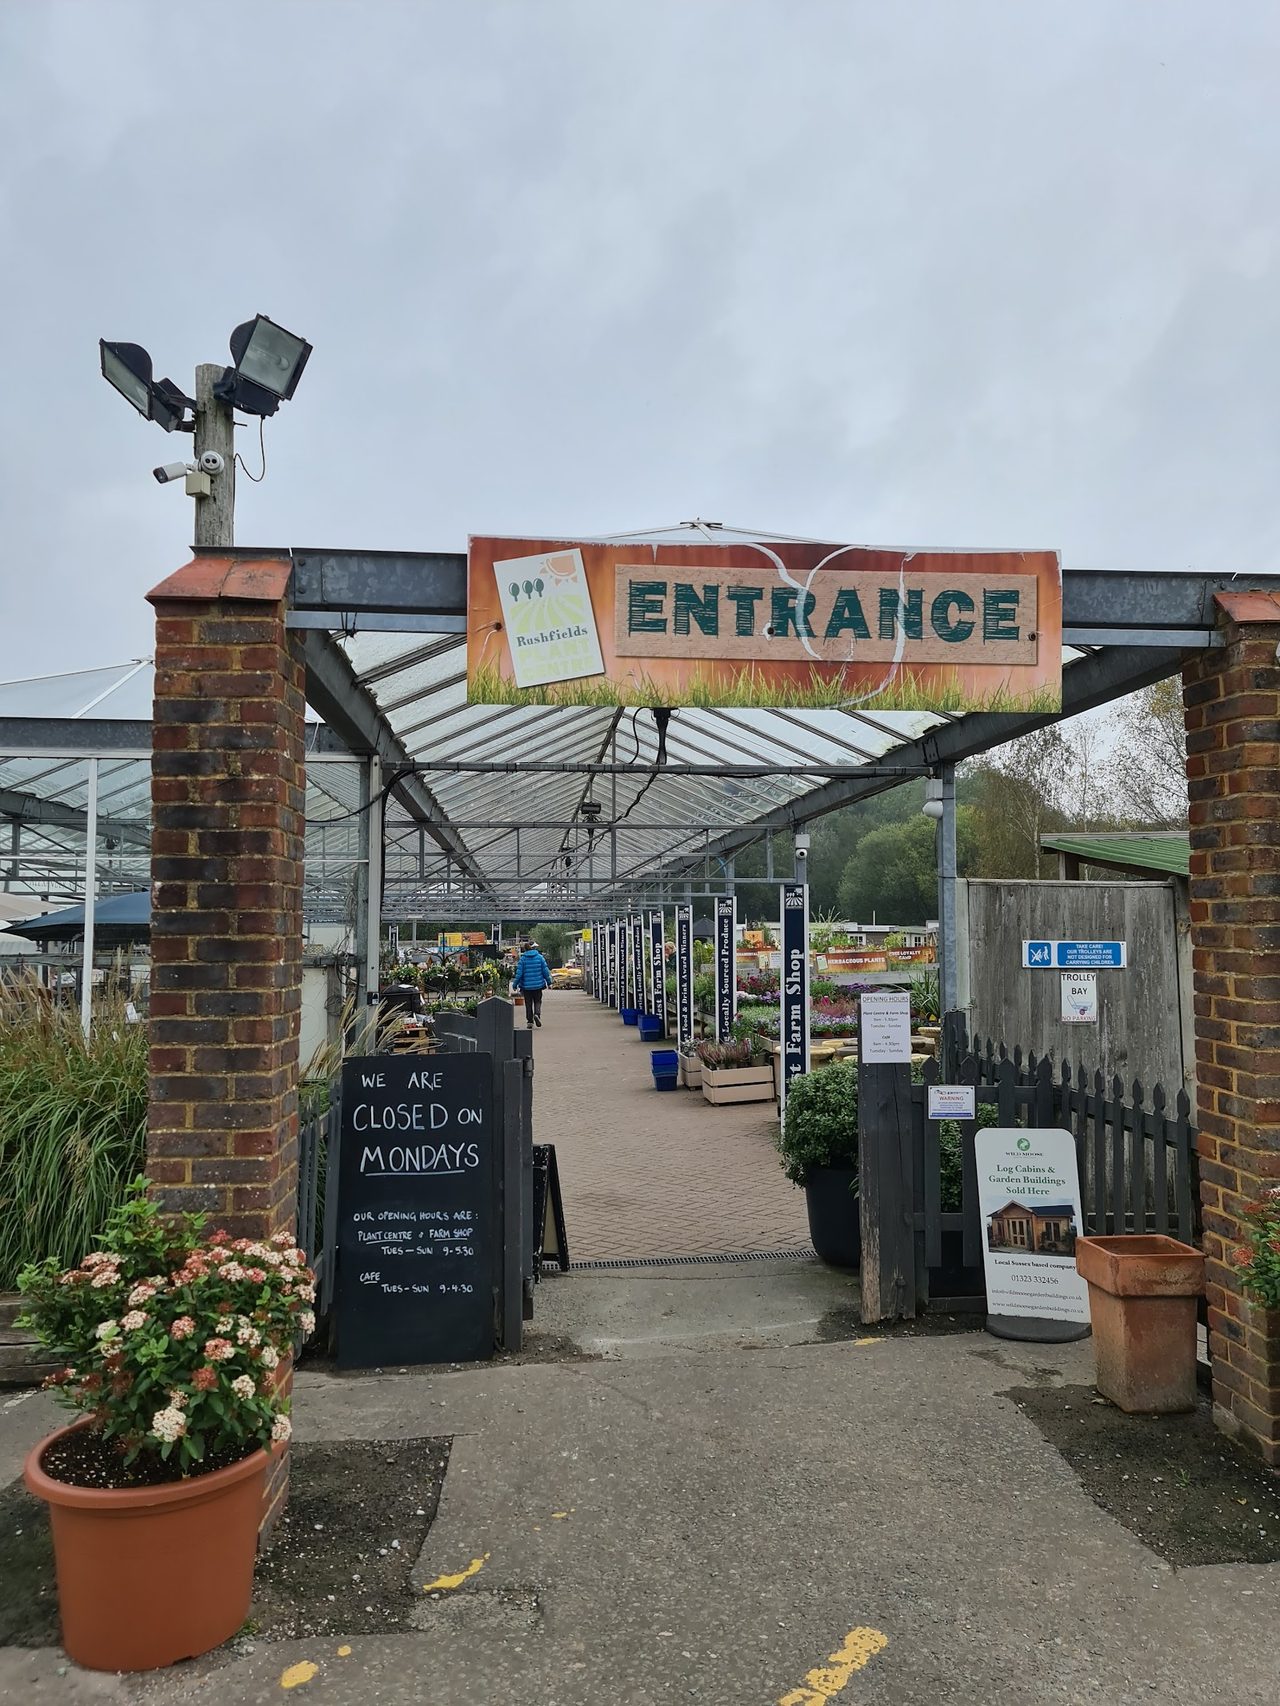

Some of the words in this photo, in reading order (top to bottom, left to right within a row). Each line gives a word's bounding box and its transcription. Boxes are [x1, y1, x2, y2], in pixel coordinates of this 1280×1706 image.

[628, 580, 1021, 643] ENTRANCE
[516, 625, 588, 647] Rushfields
[721, 918, 729, 955] Produce
[653, 942, 662, 966] Shop
[654, 970, 662, 994] Farm
[721, 957, 729, 994] Sourced
[786, 949, 804, 995] Shop
[1071, 987, 1088, 995] BAY
[722, 996, 731, 1033] Locally
[786, 1004, 802, 1055] Farm
[361, 1073, 386, 1088] WE
[407, 1071, 443, 1090] ARE
[353, 1103, 448, 1131] CLOSED
[457, 1108, 482, 1124] ON
[360, 1142, 479, 1173] MONDAYS
[997, 1164, 1014, 1174] Log
[1015, 1165, 1046, 1173] Cabins
[1048, 1166, 1056, 1174] &
[989, 1175, 1021, 1183] Garden
[1023, 1176, 1066, 1186] Buildings
[1006, 1186, 1025, 1194] Sold
[1028, 1187, 1050, 1195] Here
[353, 1211, 375, 1221] OUR
[377, 1211, 417, 1222] OPENING
[419, 1210, 449, 1220] HOURS
[429, 1228, 450, 1238] FARM
[453, 1227, 473, 1238] SHOP
[359, 1271, 380, 1282] CAFE
[1011, 1275, 1032, 1283] 01323
[1034, 1276, 1059, 1284] 332456
